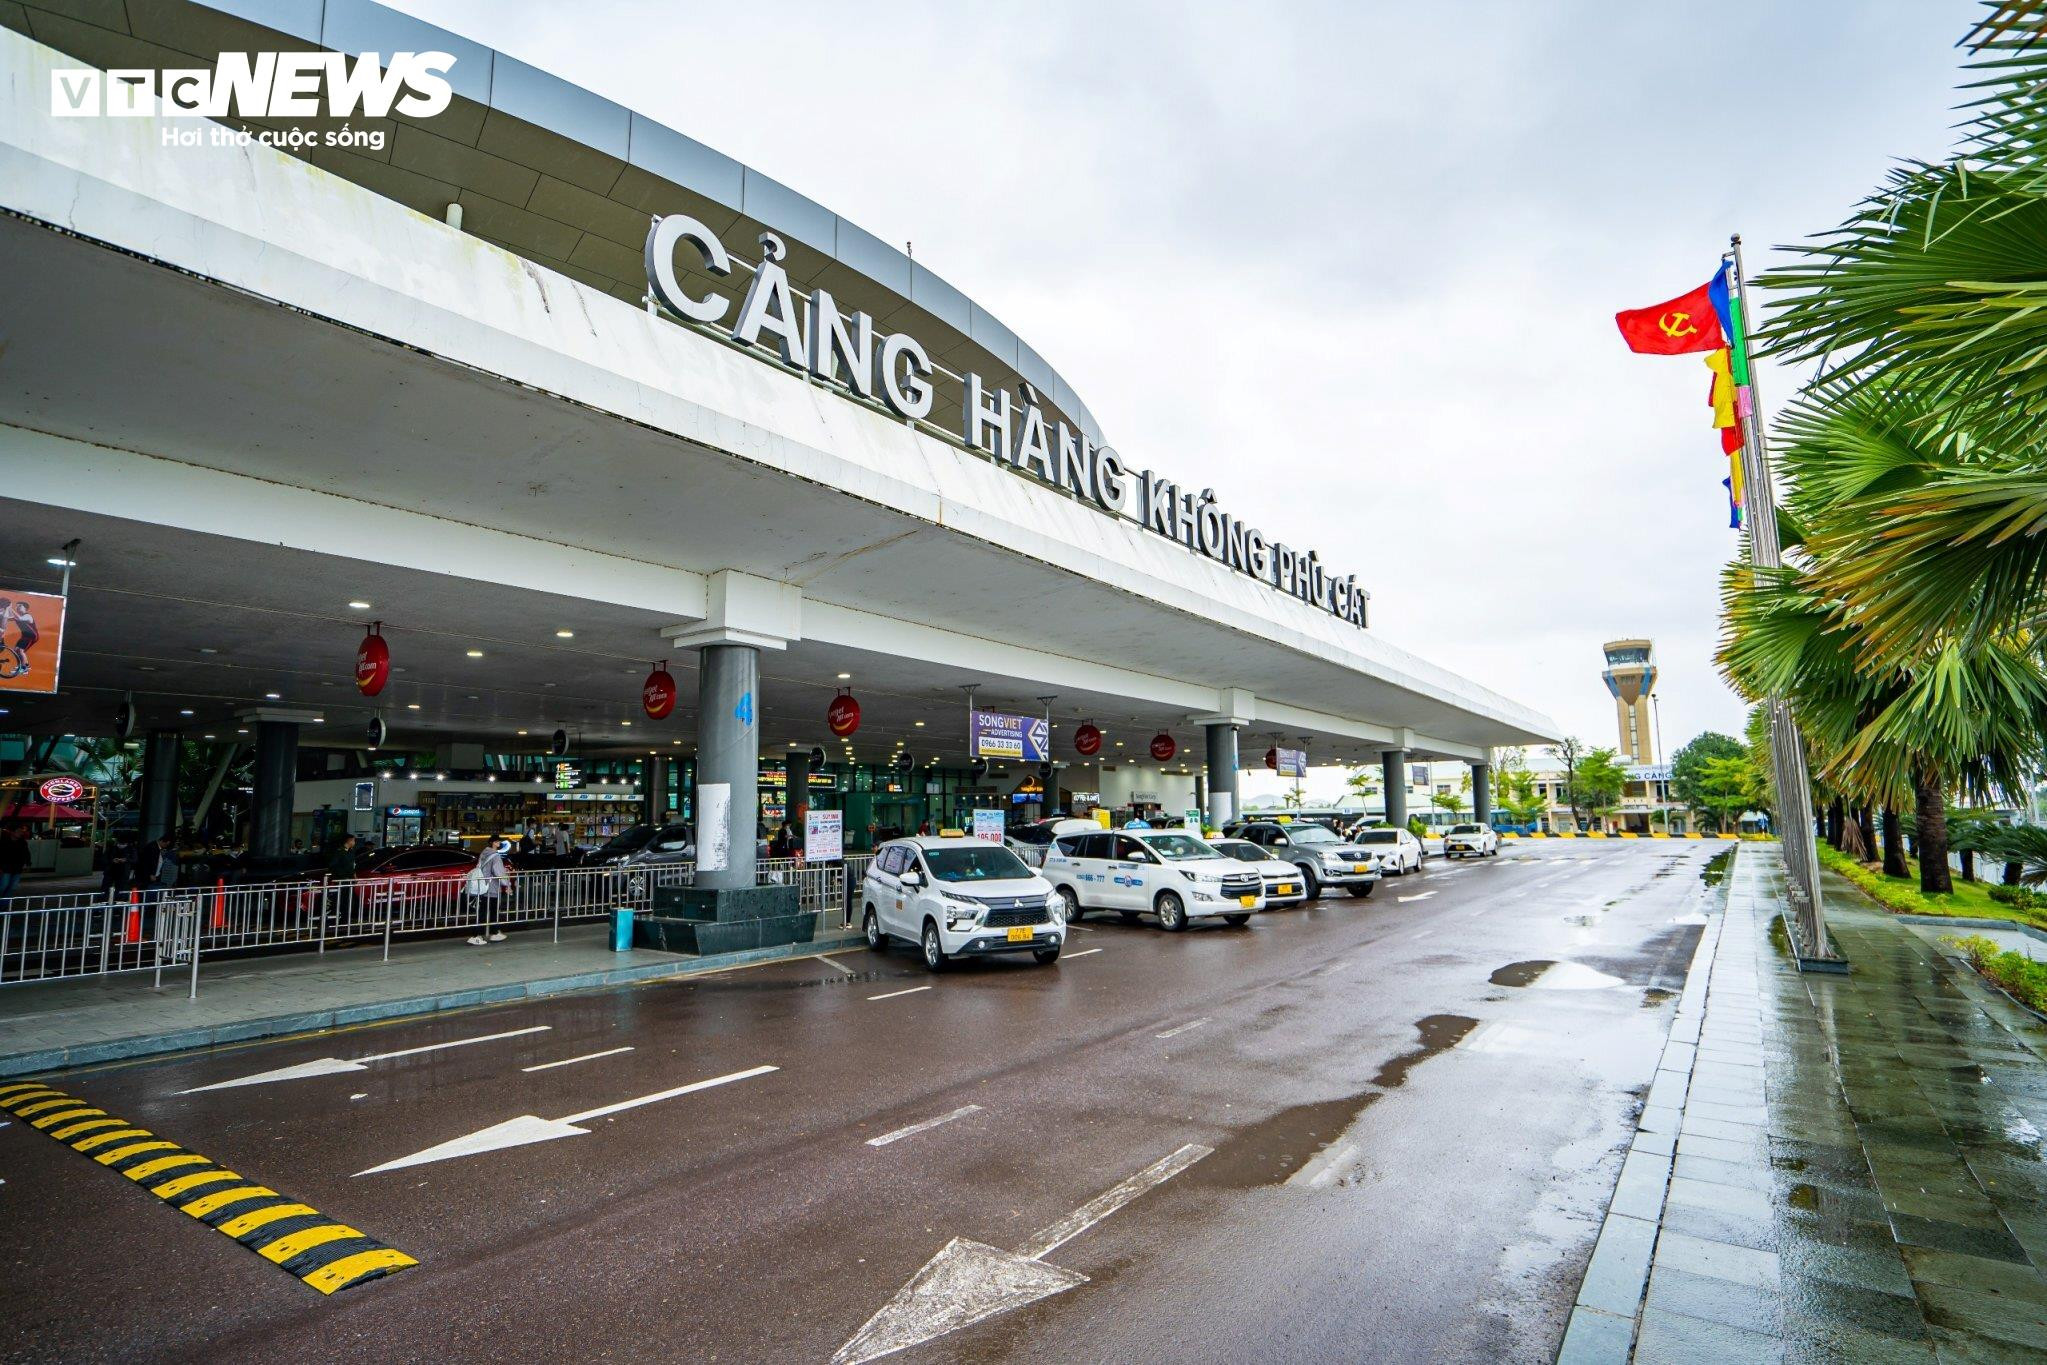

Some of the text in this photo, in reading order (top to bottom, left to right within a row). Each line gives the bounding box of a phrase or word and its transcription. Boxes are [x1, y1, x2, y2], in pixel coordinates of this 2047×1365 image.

[645, 214, 1370, 628] CẢNG HÀNG KHÔNG PHÙ CÁT
[979, 714, 1022, 730] SONGVIET
[990, 728, 1023, 738] ADVERTISING
